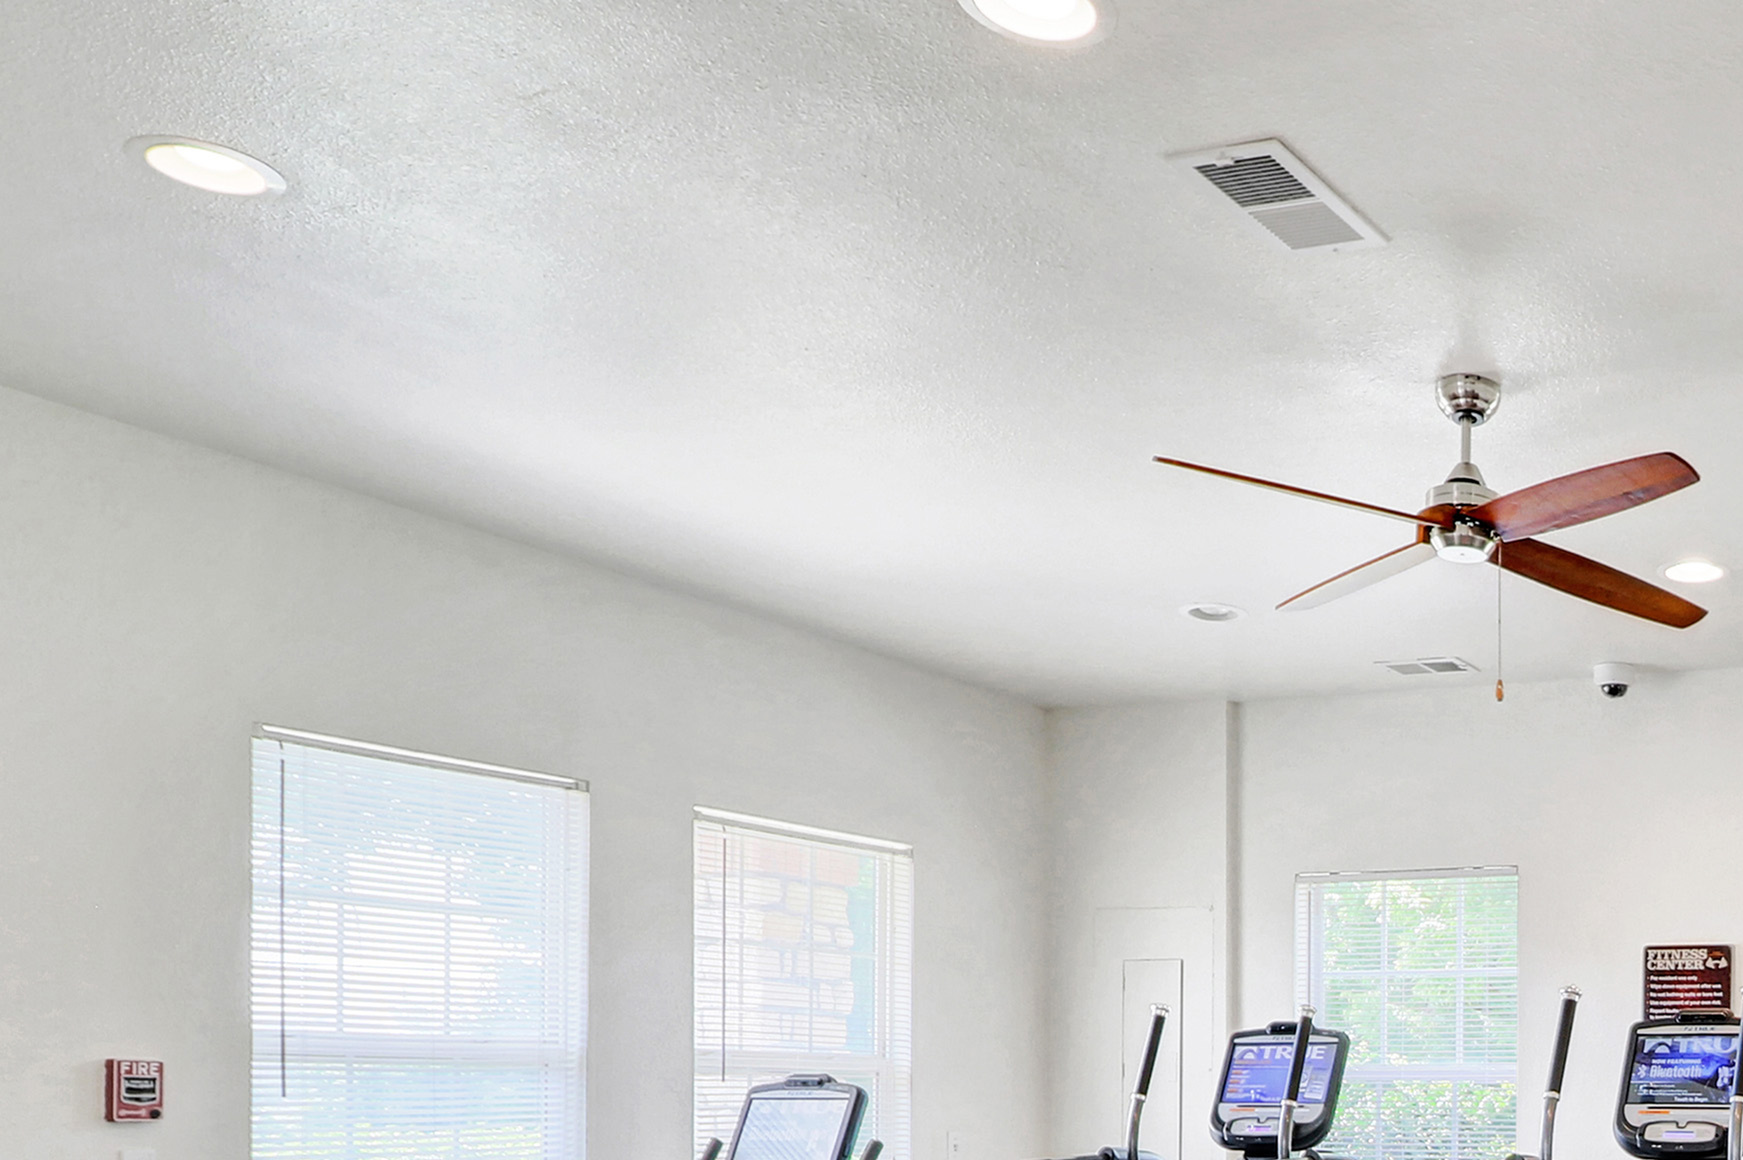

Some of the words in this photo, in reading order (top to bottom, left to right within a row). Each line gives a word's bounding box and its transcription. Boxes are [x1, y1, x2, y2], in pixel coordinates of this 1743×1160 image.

[1647, 949, 1708, 960] FITNESS
[1647, 960, 1705, 970] CENTER
[1674, 1038, 1738, 1054] TRU
[120, 1061, 160, 1076] FIRE
